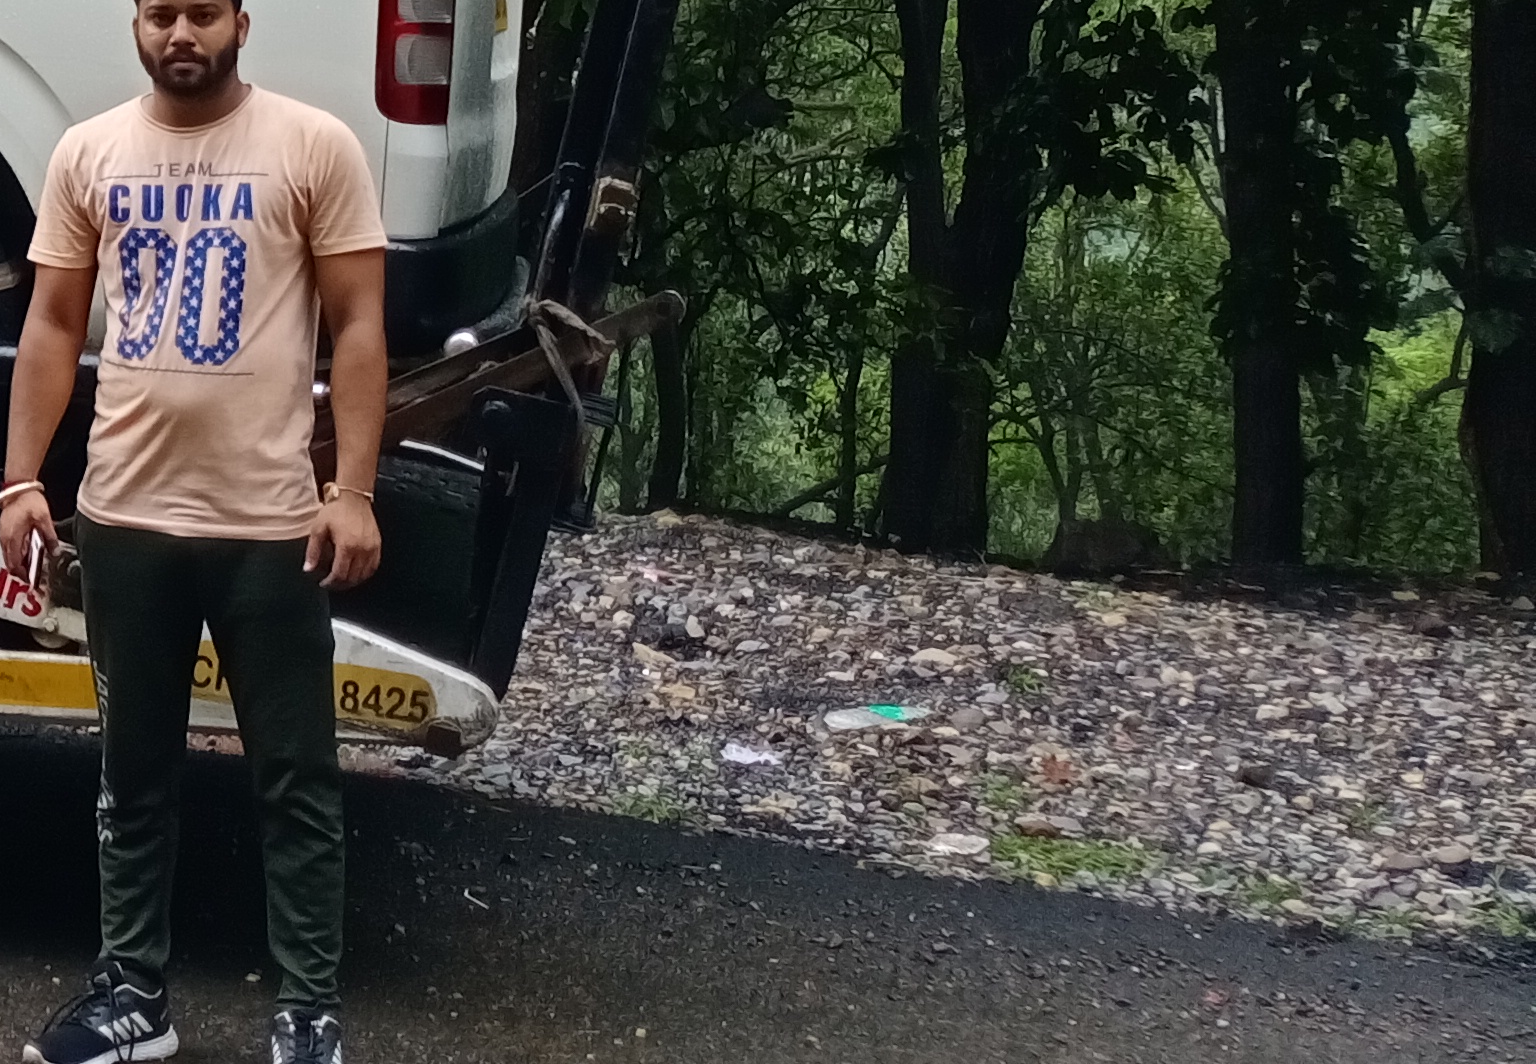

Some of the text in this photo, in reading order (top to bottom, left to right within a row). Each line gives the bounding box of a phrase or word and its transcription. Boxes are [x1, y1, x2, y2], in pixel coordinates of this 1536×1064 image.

[153, 161, 214, 178] TEAM
[108, 182, 254, 224] CUOKA
[339, 680, 430, 723] 8425
